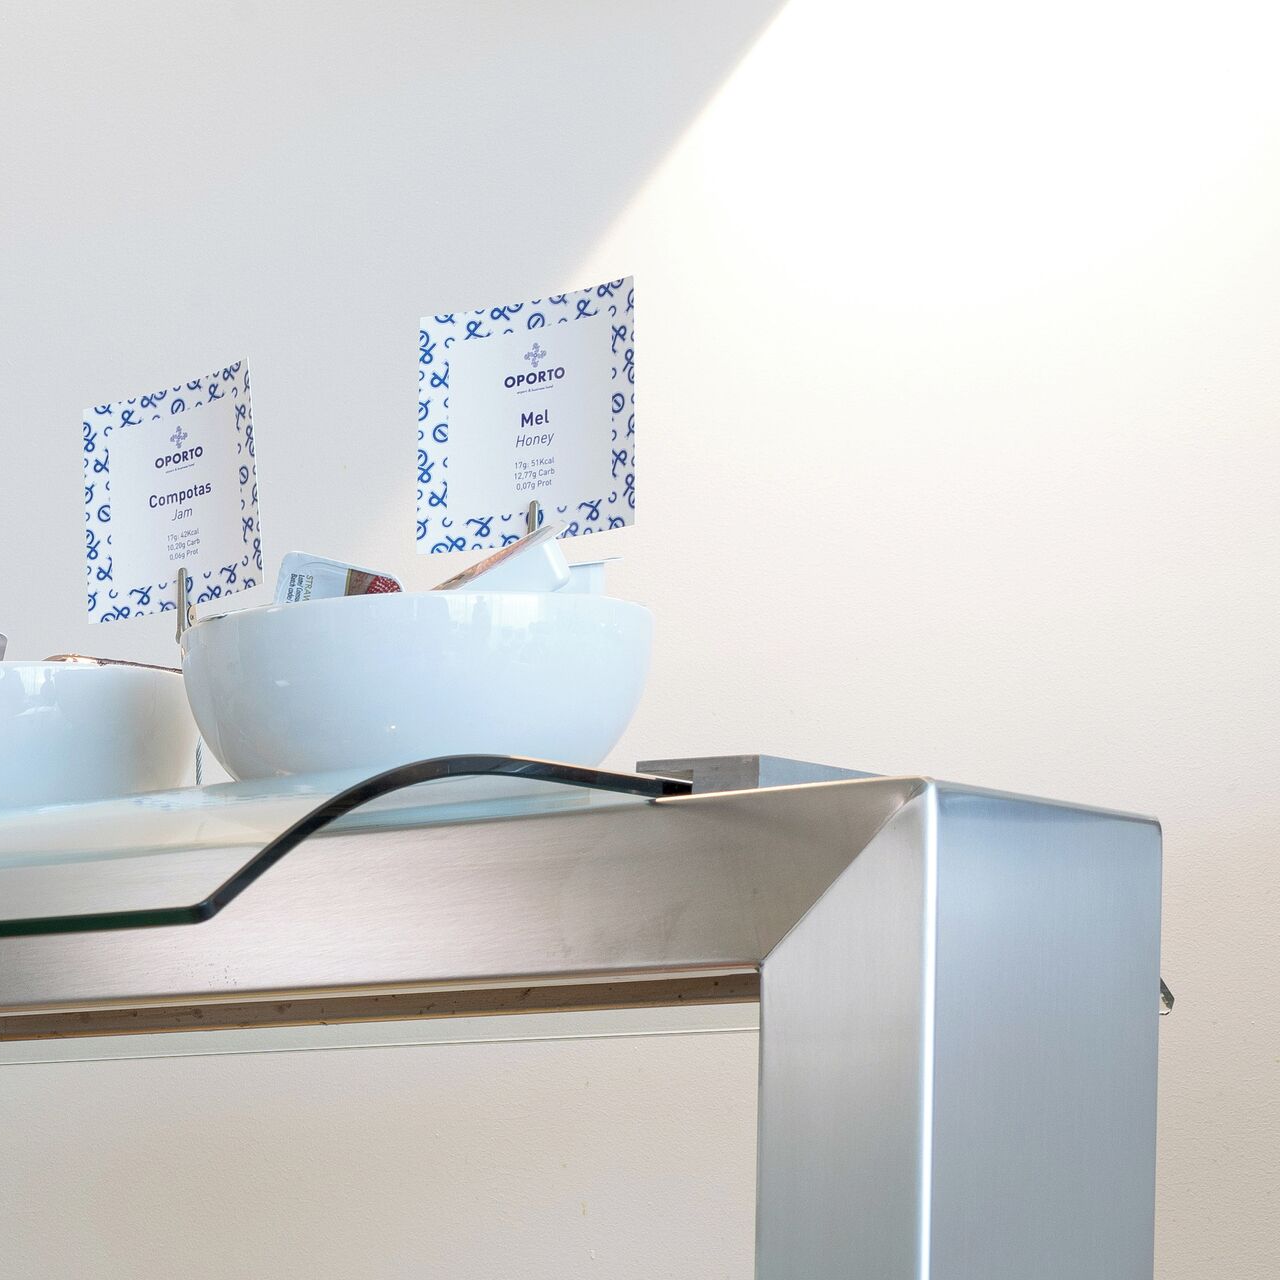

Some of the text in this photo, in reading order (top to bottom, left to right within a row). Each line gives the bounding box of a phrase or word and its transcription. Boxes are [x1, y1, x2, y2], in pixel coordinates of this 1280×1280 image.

[504, 366, 565, 388] OPORTO
[521, 409, 549, 427] Mel
[515, 433, 554, 447] Honey
[155, 446, 203, 468] OPORTO
[531, 457, 555, 466] 51Kcal
[538, 467, 555, 476] Carb
[537, 479, 552, 487] Prot
[149, 482, 212, 508] Compotas
[171, 507, 193, 521] Jam
